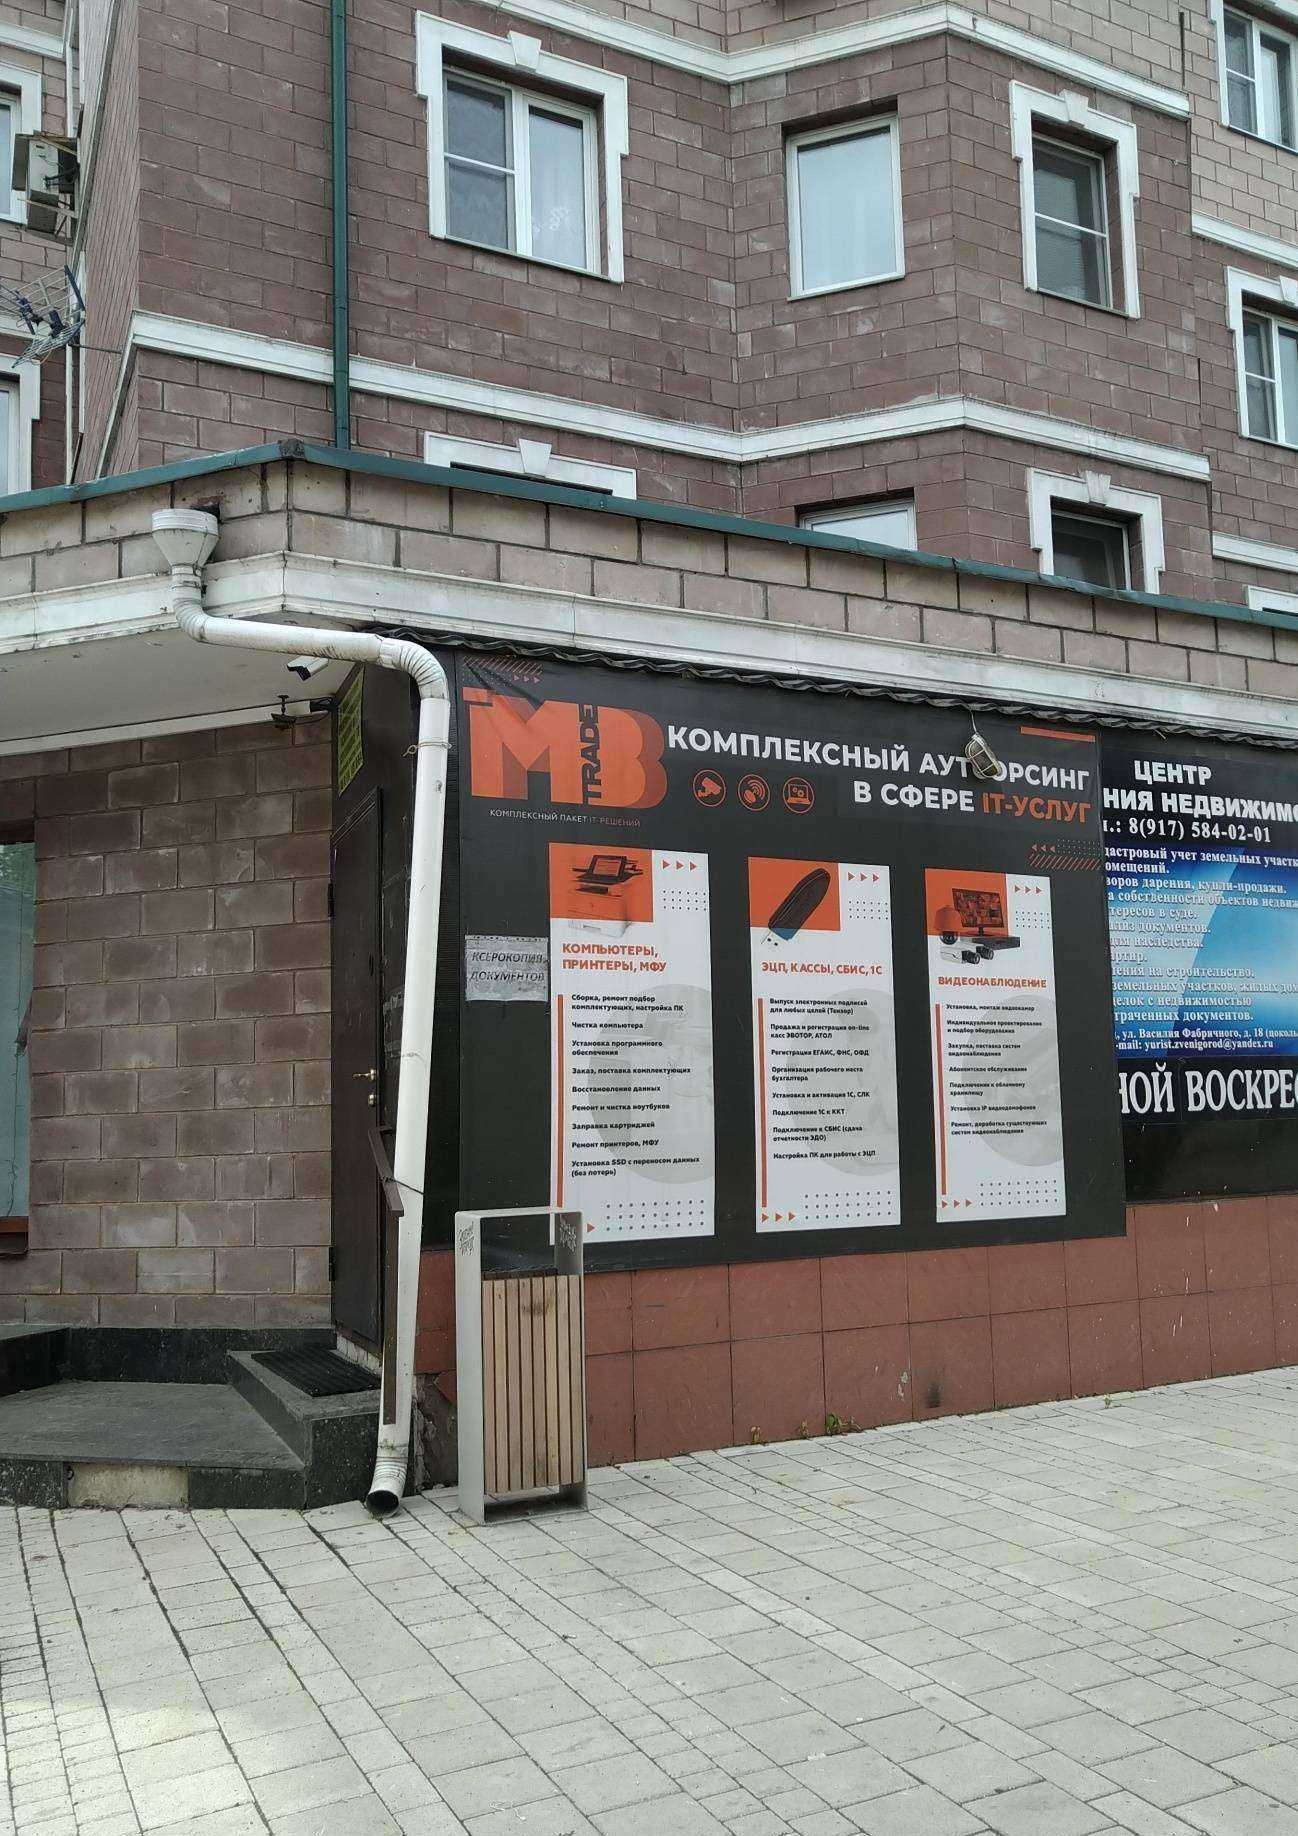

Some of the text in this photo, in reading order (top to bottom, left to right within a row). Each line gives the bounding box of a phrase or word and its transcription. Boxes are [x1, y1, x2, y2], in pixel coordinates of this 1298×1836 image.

[579, 703, 602, 808] TRADE
[668, 725, 1090, 791] КОМПЛЕКСНЫЙ АУТОРСИНГ
[1134, 760, 1212, 786] ЦЕНТР
[853, 780, 1091, 824] В СФЕРЕ IT-УСЛУГ
[1103, 787, 1154, 811] НИЯ
[489, 809, 558, 821] КОМПЛЕКСНЫЙ
[560, 814, 587, 823] ПАКЕТ
[1129, 817, 1185, 840] 8(917)
[1191, 822, 1271, 843] 584-02-01
[1171, 851, 1197, 863] учет
[1200, 852, 1262, 865] земельных
[1105, 862, 1170, 874] омещений.
[1142, 878, 1287, 896] дарения, купли-продажи.
[1118, 889, 1204, 905] собственности
[1209, 893, 1259, 907] объектов
[1160, 909, 1167, 918] в
[1169, 909, 1198, 921] суде.
[1138, 922, 1211, 936] документов.
[1134, 936, 1204, 949] наследства.
[562, 943, 658, 958] КОМПЬЮТЕРЫ,
[562, 959, 667, 973] ПРИНТЕРЫ, МФУ
[790, 963, 834, 975] КАССЫ,
[836, 964, 869, 976] СБИС,
[470, 971, 545, 982] ДОКУМЕНТОВ
[1149, 967, 1255, 981] на строительство.
[938, 976, 1047, 988] ВИДЕОНАБЛЮДЕНИЕ
[1180, 982, 1237, 995] участков,
[571, 994, 600, 1002] Сборка,
[629, 995, 656, 1003] подбор
[770, 998, 794, 1006] Выпуск
[1148, 996, 1252, 1008] с недвижимостью
[1182, 1010, 1254, 1024] документов.
[599, 1022, 644, 1030] компьютера
[1122, 1030, 1136, 1041] ул.
[1139, 1028, 1180, 1038] Василия
[1182, 1028, 1242, 1040] Фабричного,
[1254, 1028, 1264, 1038] 18
[1145, 1038, 1274, 1051] yurist.zvenigorod@yandex.ru
[1185, 1068, 1298, 1112] ВОСКРЕ
[632, 1103, 670, 1111] ноутбуков
[609, 1122, 655, 1130] картриджей
[633, 1158, 672, 1166] переносом
[571, 1168, 617, 1177] (без потерь)
